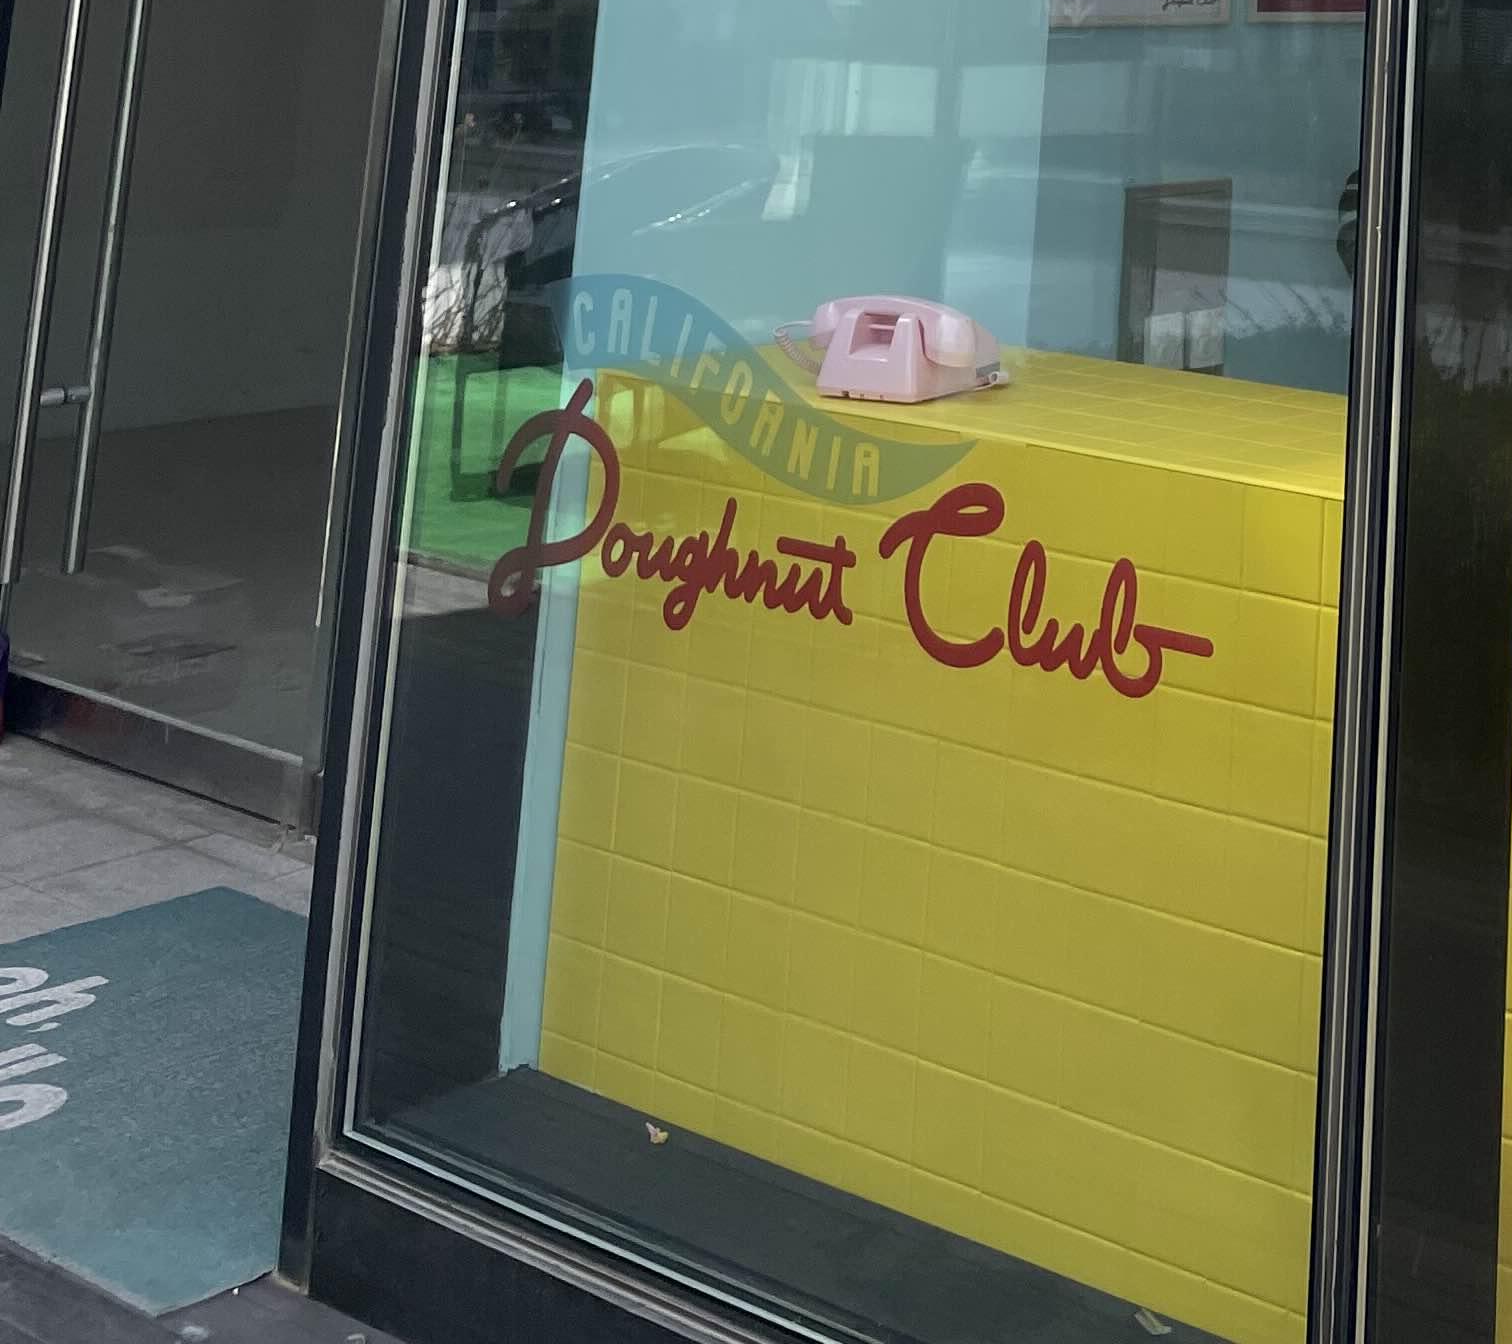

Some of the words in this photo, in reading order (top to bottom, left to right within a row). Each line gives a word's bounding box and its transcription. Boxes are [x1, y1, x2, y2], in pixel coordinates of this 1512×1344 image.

[572, 286, 881, 498] CALIFORNIA
[486, 378, 856, 631] Doughnut
[877, 482, 1214, 698] Club
